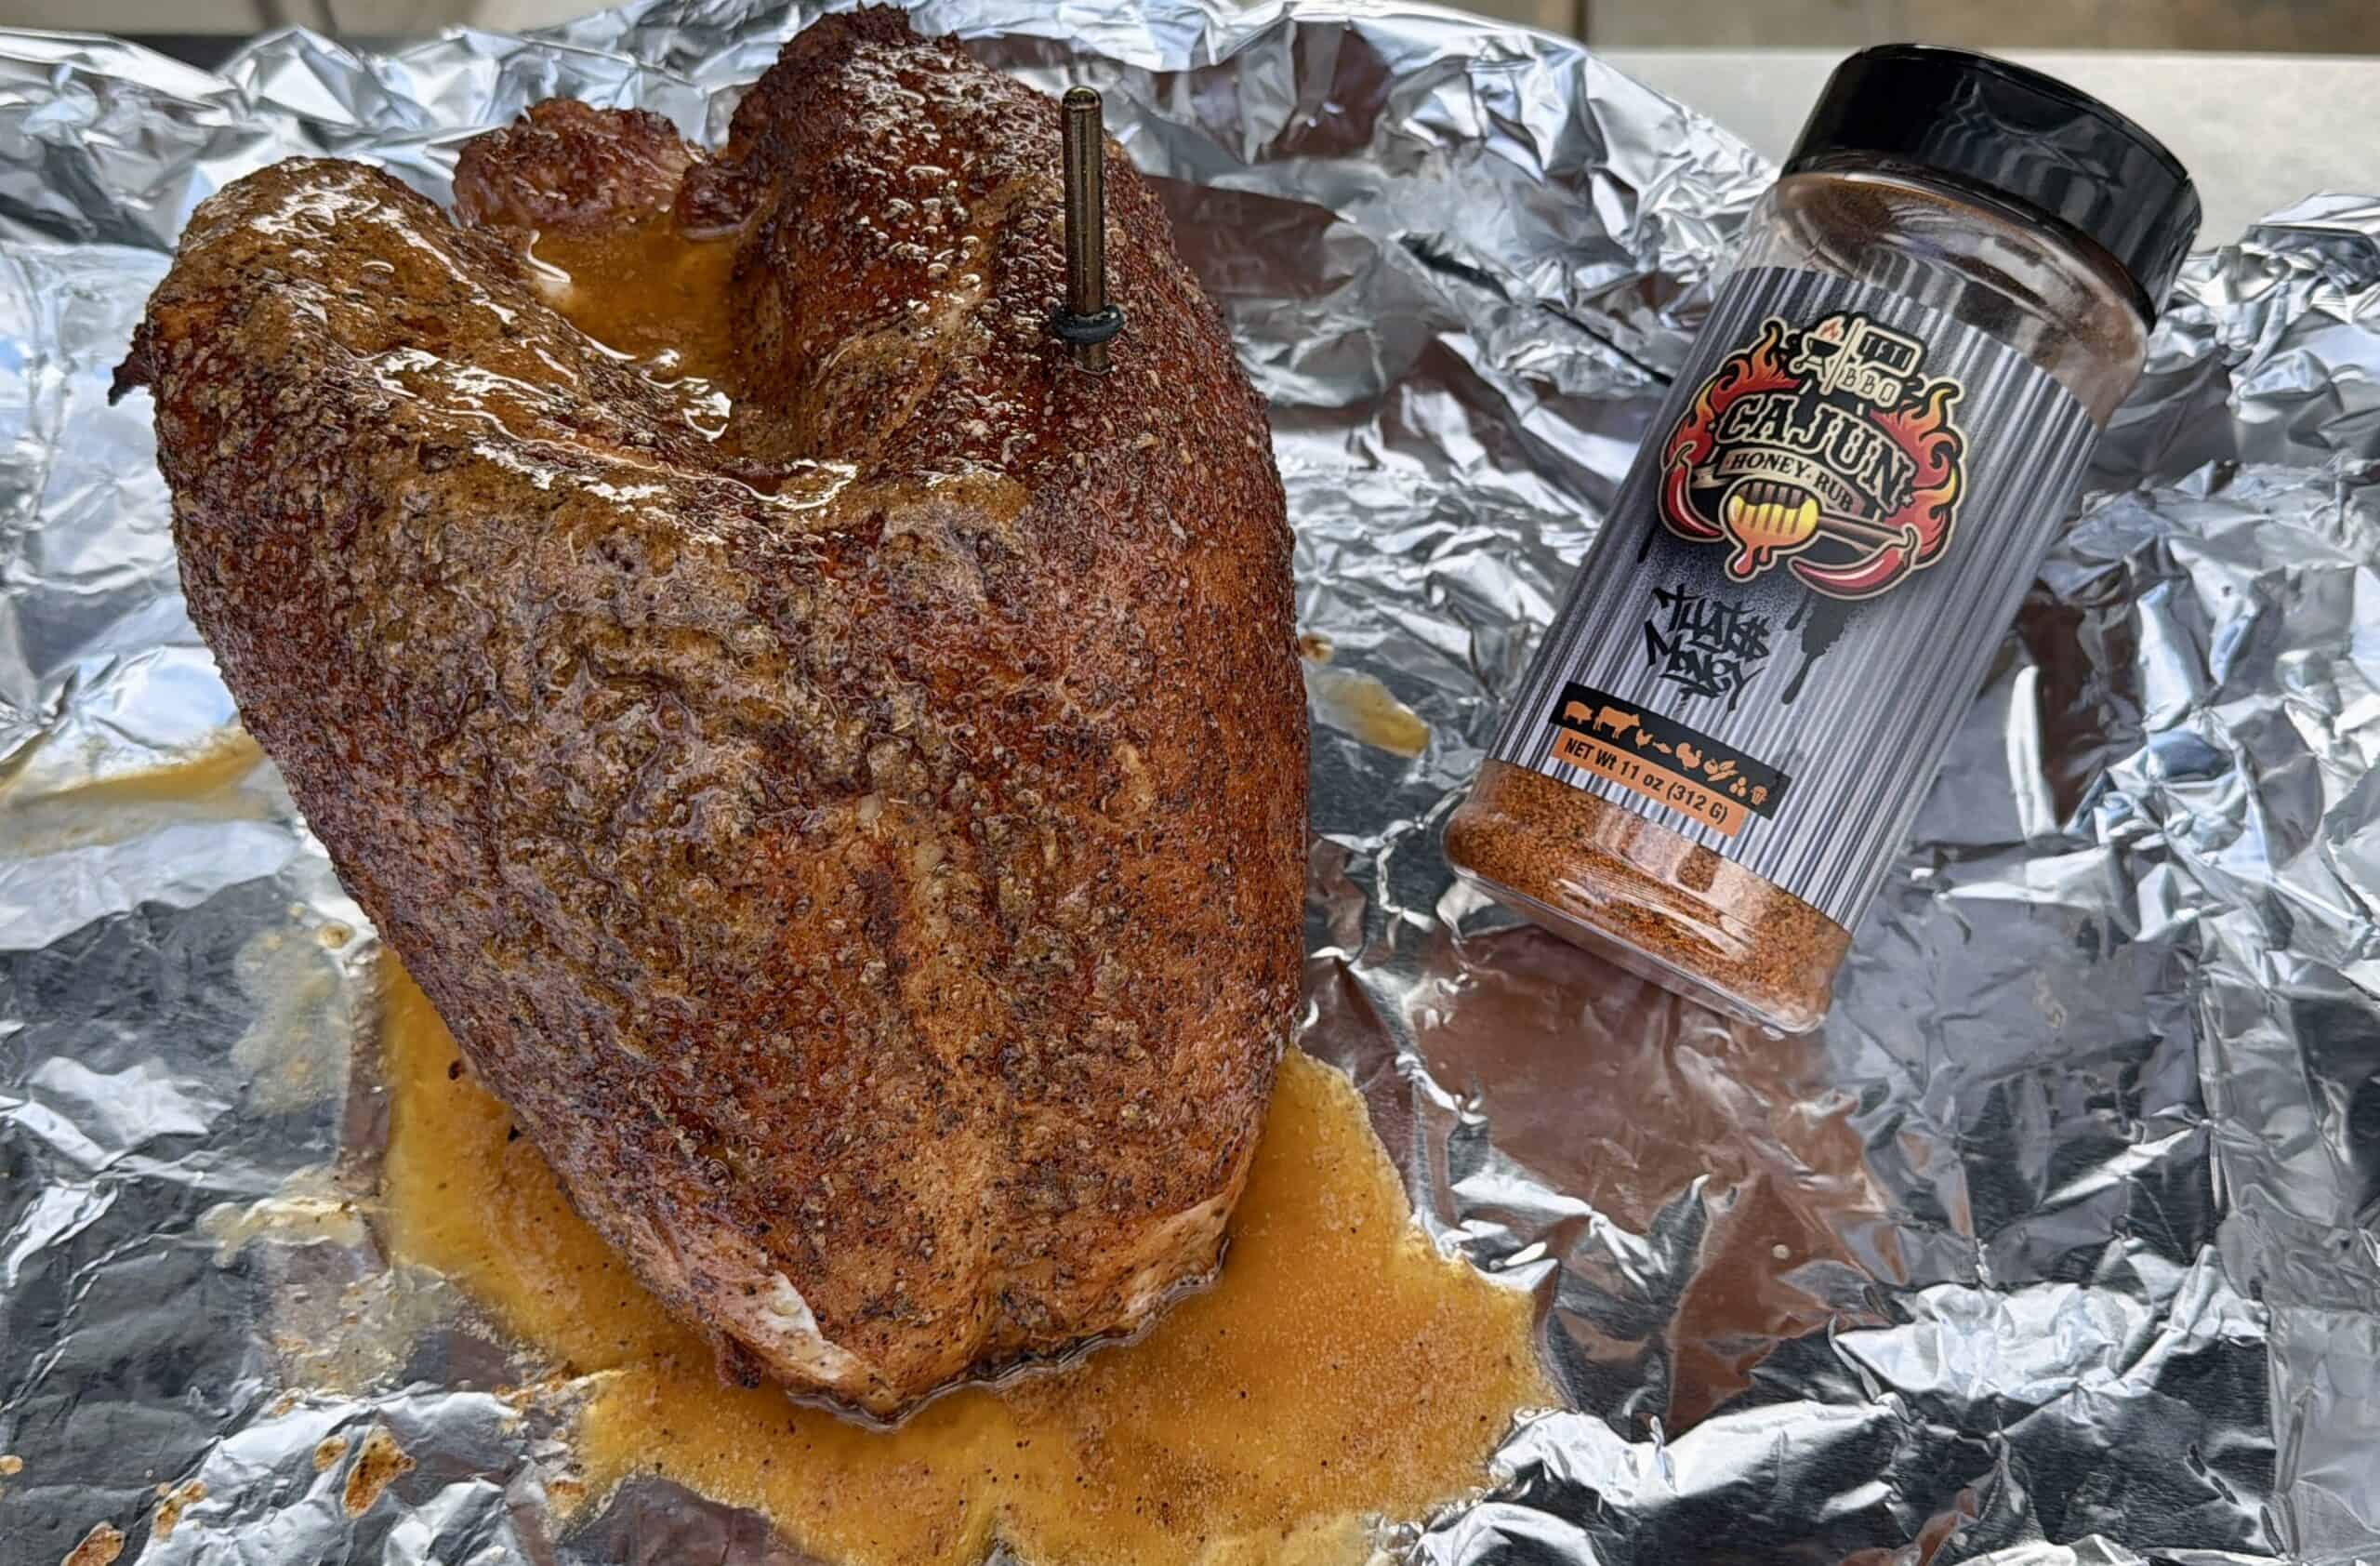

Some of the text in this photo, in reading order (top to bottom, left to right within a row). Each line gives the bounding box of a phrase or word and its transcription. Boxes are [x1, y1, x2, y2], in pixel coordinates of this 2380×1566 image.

[1717, 395, 1915, 512] CAJUN
[1730, 452, 1855, 511] HONEY RUB
[1564, 737, 1729, 824] NET Wt 11 oz (312 G)
